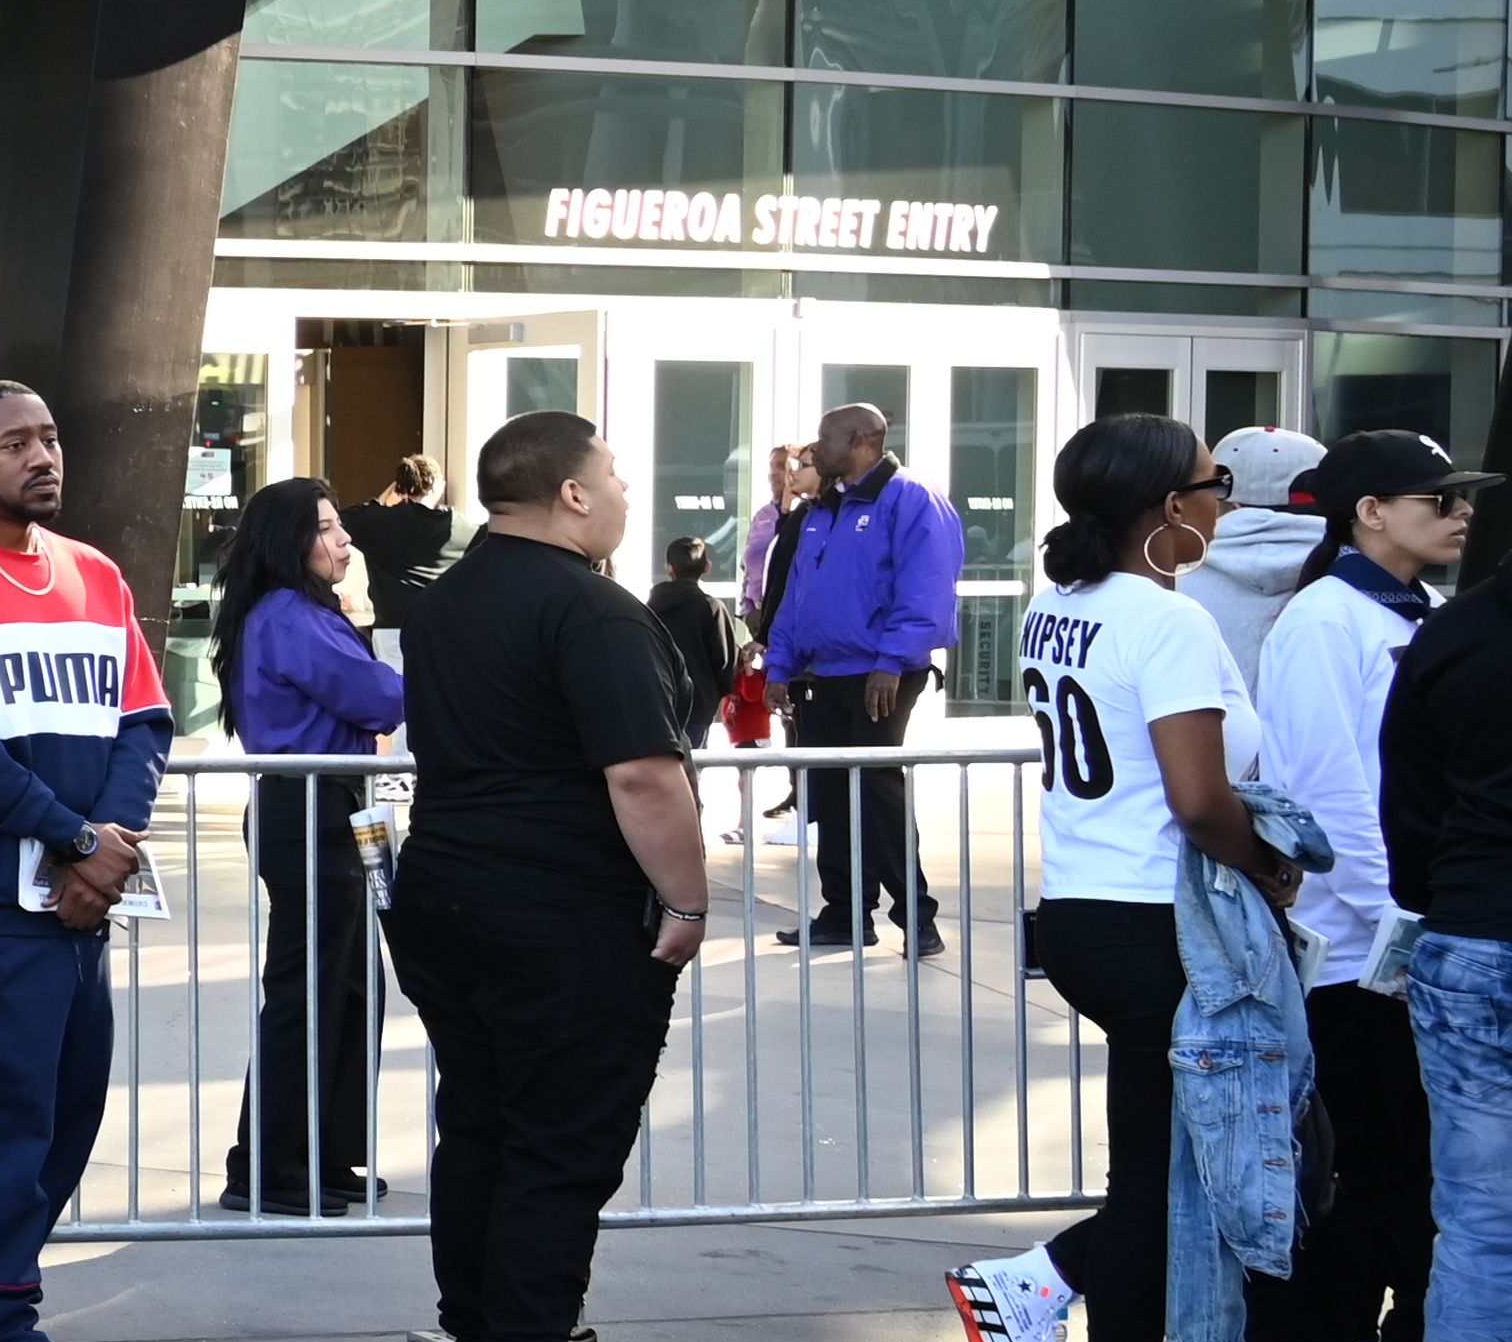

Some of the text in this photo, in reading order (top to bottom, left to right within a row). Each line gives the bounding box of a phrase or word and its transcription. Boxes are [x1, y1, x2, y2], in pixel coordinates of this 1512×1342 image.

[543, 187, 999, 253] FIGUEROA STREET ENTRY
[977, 621, 993, 697] SECURITY
[1019, 611, 1103, 670] NIPSEY
[1022, 666, 1114, 800] 60
